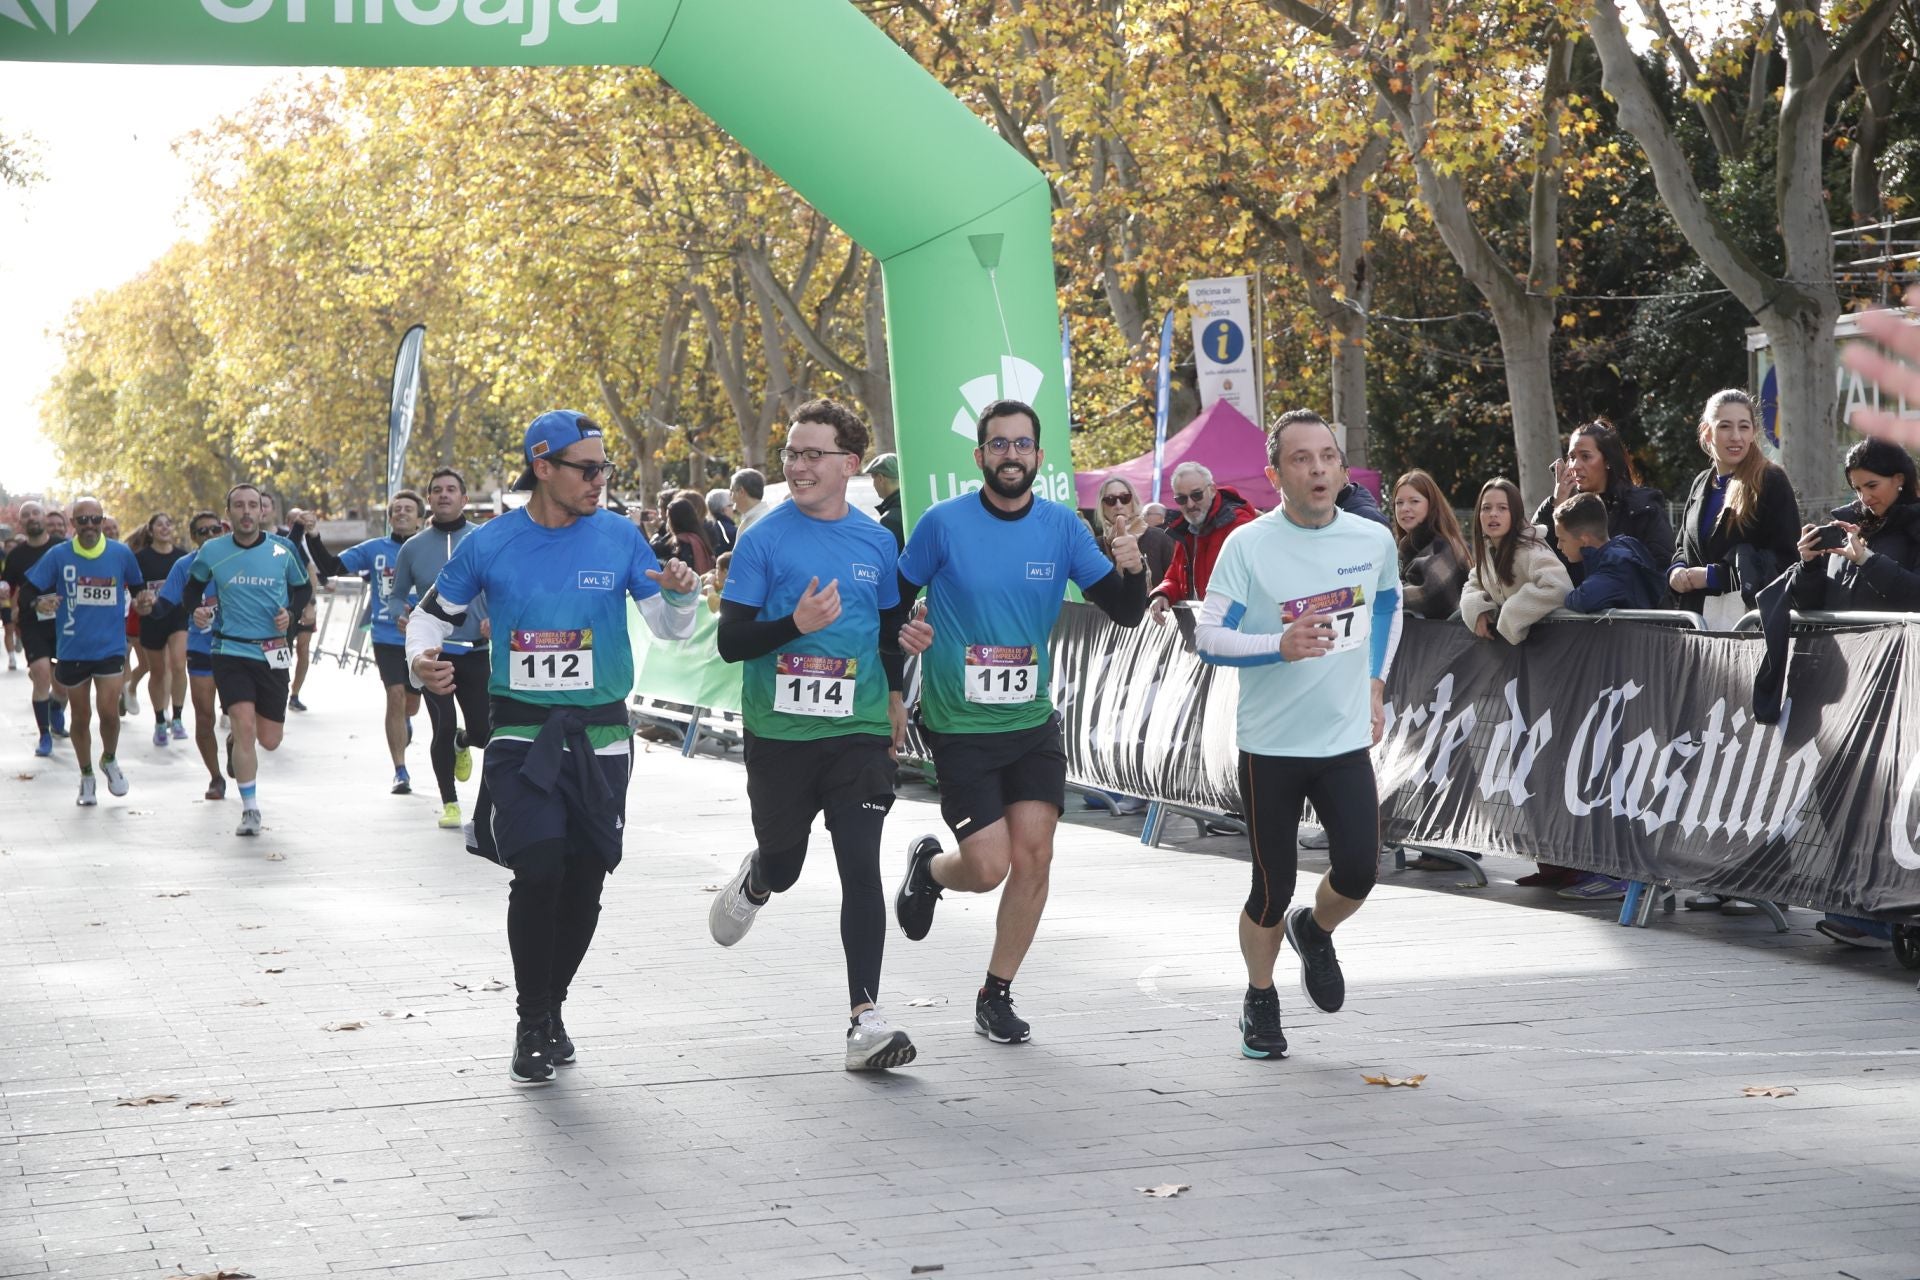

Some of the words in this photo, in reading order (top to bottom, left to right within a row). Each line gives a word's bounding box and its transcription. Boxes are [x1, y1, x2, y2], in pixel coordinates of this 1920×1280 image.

[929, 463, 1070, 505] Unaja
[857, 569, 871, 578] AVL
[1030, 568, 1044, 576] AVL
[1337, 561, 1373, 575] OneHealth
[228, 576, 276, 586] ADIENT
[583, 576, 600, 585] AVL
[63, 565, 78, 635] IVECO
[83, 587, 111, 600] 589
[521, 653, 579, 679] 112
[978, 669, 1028, 692] 113
[788, 678, 842, 705] 114
[1478, 677, 1552, 807] de
[1564, 679, 1822, 846] Castilla
